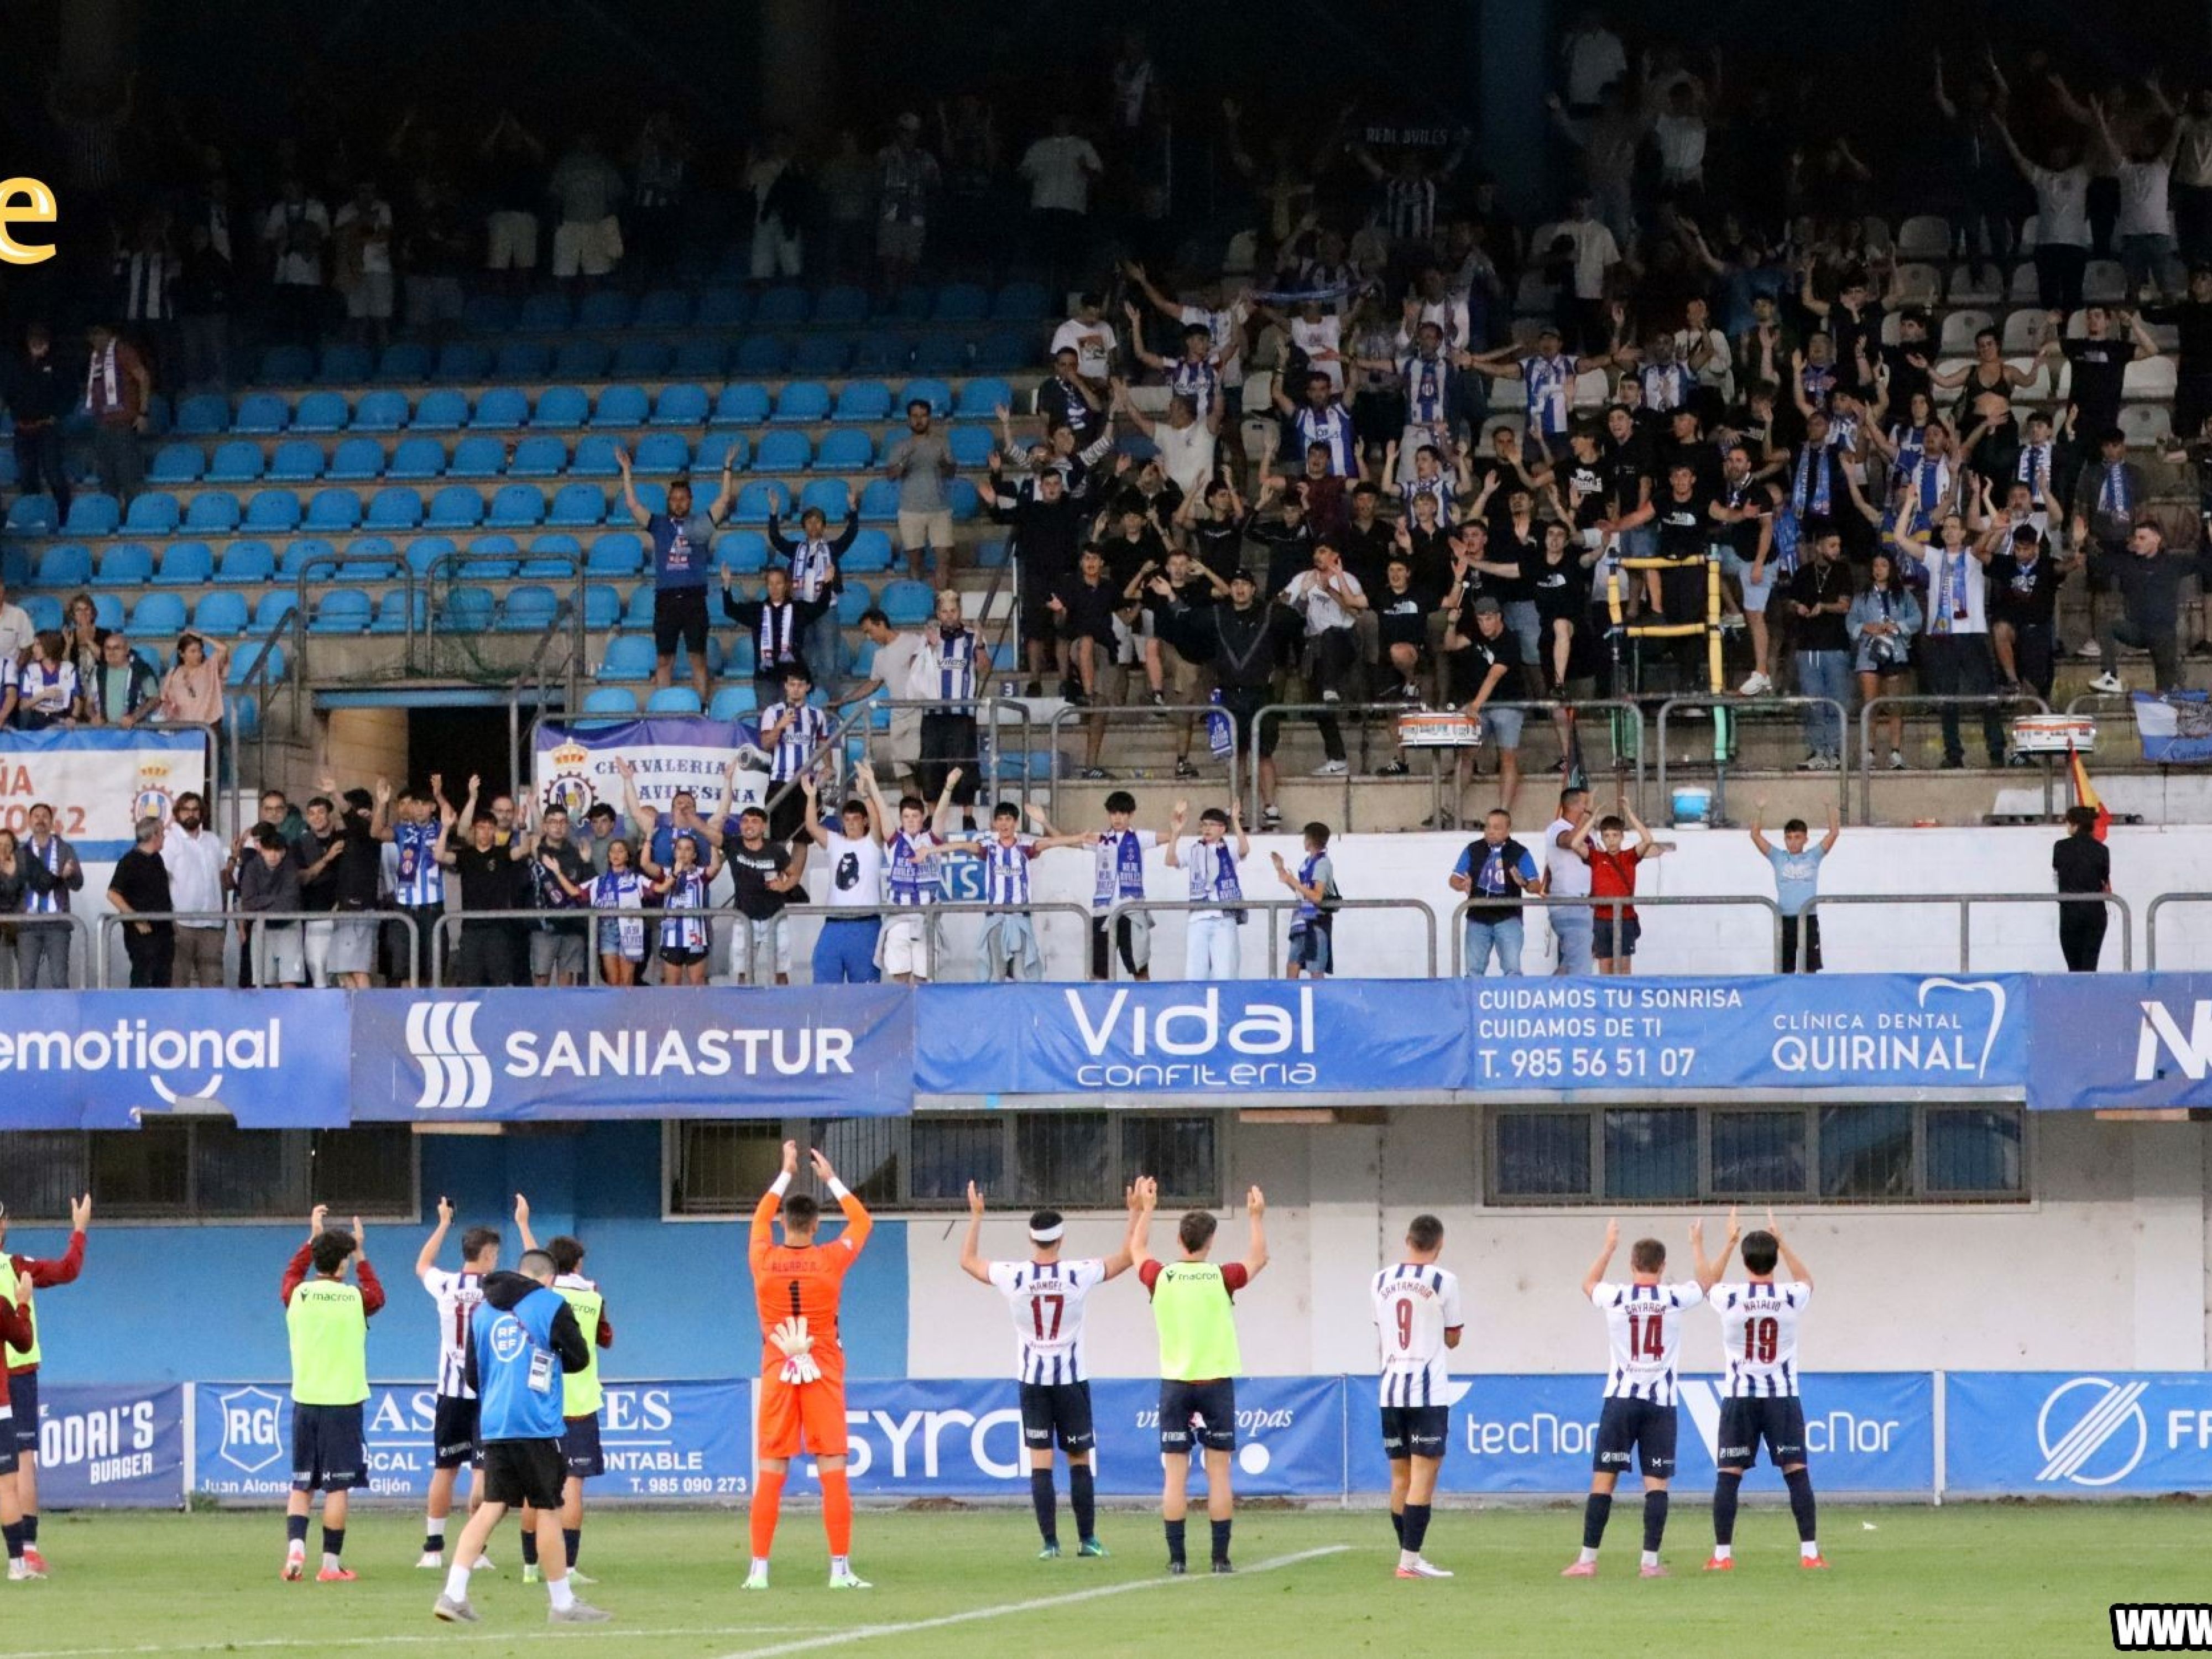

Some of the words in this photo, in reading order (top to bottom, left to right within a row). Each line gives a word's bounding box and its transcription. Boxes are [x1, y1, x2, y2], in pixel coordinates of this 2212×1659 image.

[1004, 682, 1014, 696] 3
[1479, 989, 1597, 1009] CUIDAMOS
[1603, 989, 1632, 1009] TU
[1641, 988, 1743, 1009] SONRISA
[1065, 987, 1315, 1056] Vidal
[1479, 1019, 1597, 1038] CUIDAMOS
[1605, 1018, 1635, 1037] DE
[1641, 1018, 1662, 1037] TI
[1773, 1010, 1864, 1030] CLÍNICA
[1879, 1013, 1962, 1030] DENTAL
[505, 1028, 854, 1078] SANIASTUR
[1478, 1050, 1501, 1078] T.
[1511, 1048, 1562, 1077] 985
[1572, 1048, 1607, 1077] 56
[1616, 1048, 1646, 1077] 51
[1660, 1048, 1696, 1076] 07
[1772, 1036, 1976, 1072] QUIRINAL
[1178, 1272, 1218, 1281] macron
[313, 1292, 355, 1302] macron
[789, 1280, 801, 1317] 1
[1031, 1295, 1064, 1340] 17
[1396, 1298, 1413, 1350] 9
[1629, 1315, 1665, 1361] 14
[1744, 1317, 1778, 1363] 19
[34, 1401, 154, 1468] ODRI'S
[229, 1409, 274, 1445] RG
[1804, 1411, 1899, 1453] cNor
[90, 1453, 153, 1485] BURGER
[603, 1452, 703, 1470] NTABLE
[201, 1480, 239, 1494] Juan
[630, 1478, 643, 1493] T.
[649, 1478, 678, 1493] 985
[684, 1477, 712, 1493] 090
[717, 1477, 747, 1493] 273
